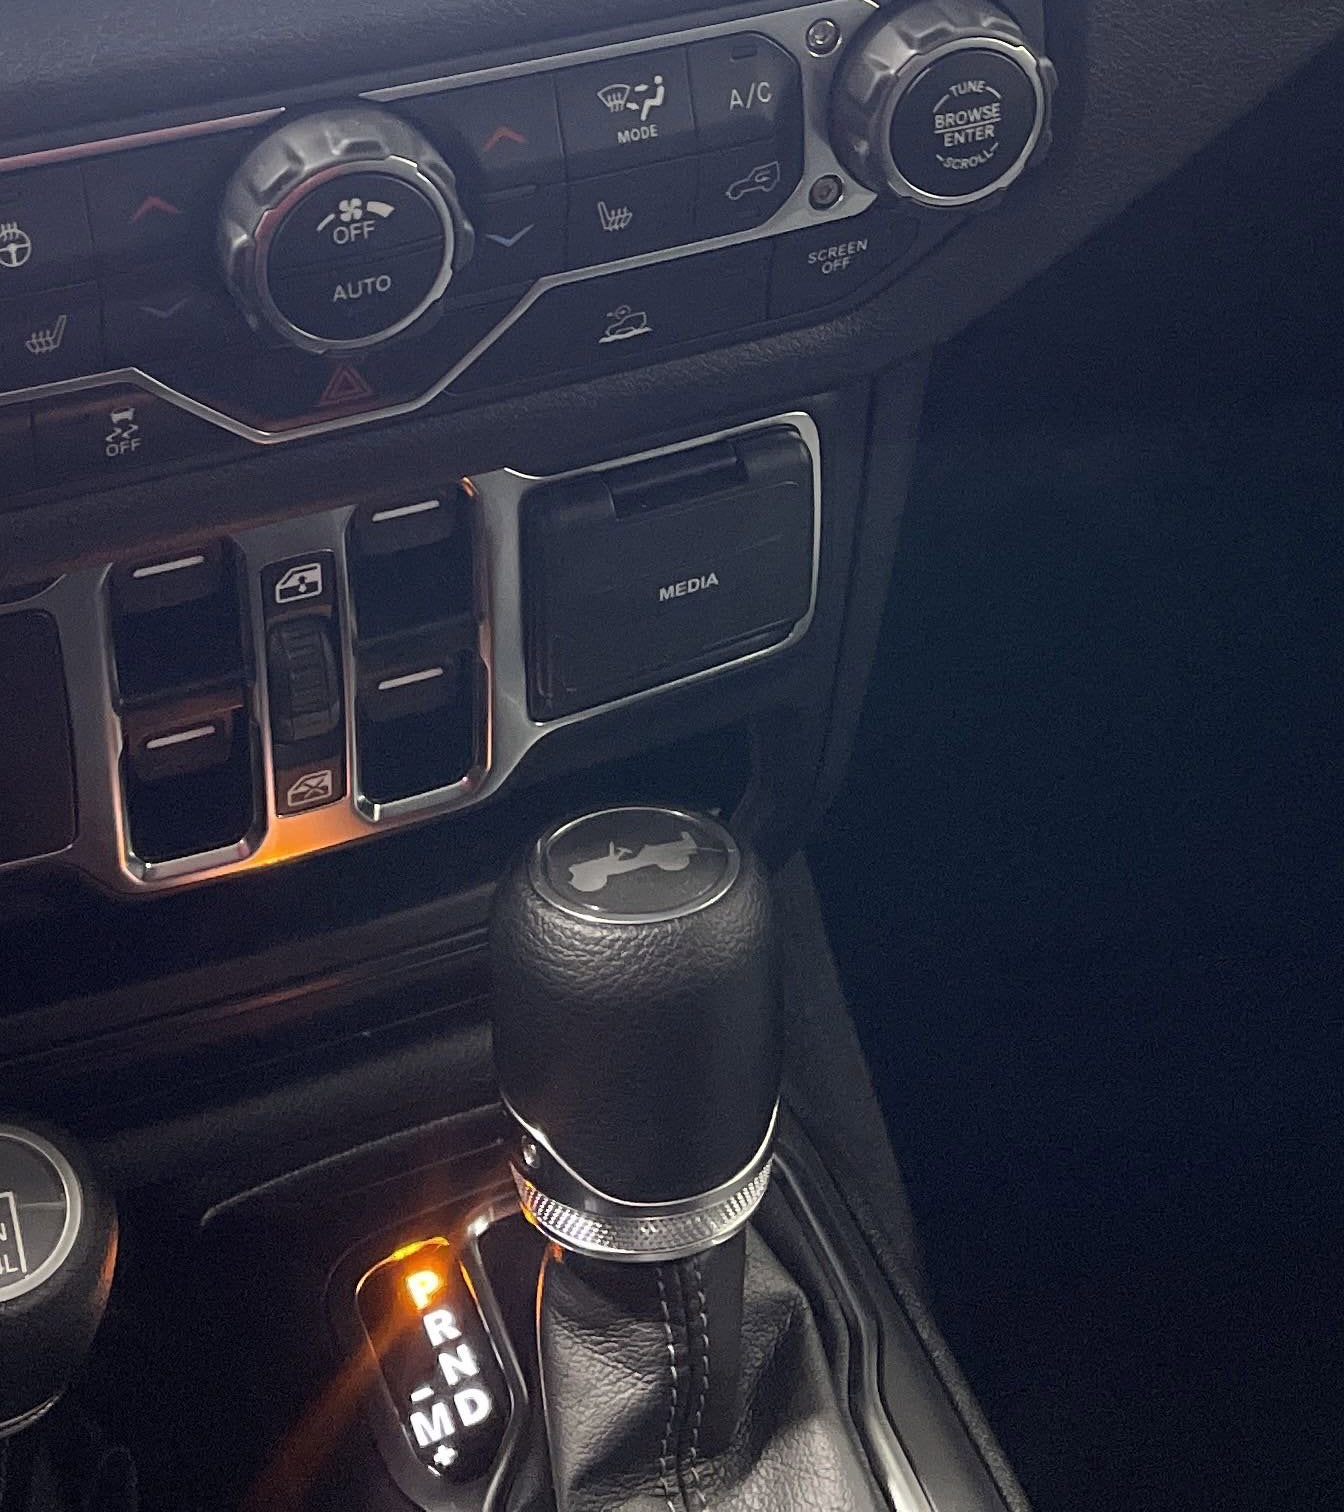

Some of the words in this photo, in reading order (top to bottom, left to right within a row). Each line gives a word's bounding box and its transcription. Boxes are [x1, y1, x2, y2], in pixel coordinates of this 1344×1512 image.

[728, 81, 774, 111] A/C
[948, 80, 987, 98] TUNE
[934, 102, 1002, 129] BROWSE
[616, 123, 660, 145] MODE
[943, 125, 995, 147] ENTER
[942, 149, 995, 170] SCROLL
[332, 220, 376, 245] OFF
[807, 238, 869, 265] SCREEN
[821, 255, 852, 275] OFF
[332, 275, 393, 303] AUTO
[106, 437, 142, 457] OFF
[659, 572, 719, 602] MEDIA
[406, 1270, 442, 1311] P
[422, 1309, 462, 1347] R
[438, 1344, 479, 1386] N
[453, 1387, 492, 1427] D
[409, 1401, 456, 1448] M
